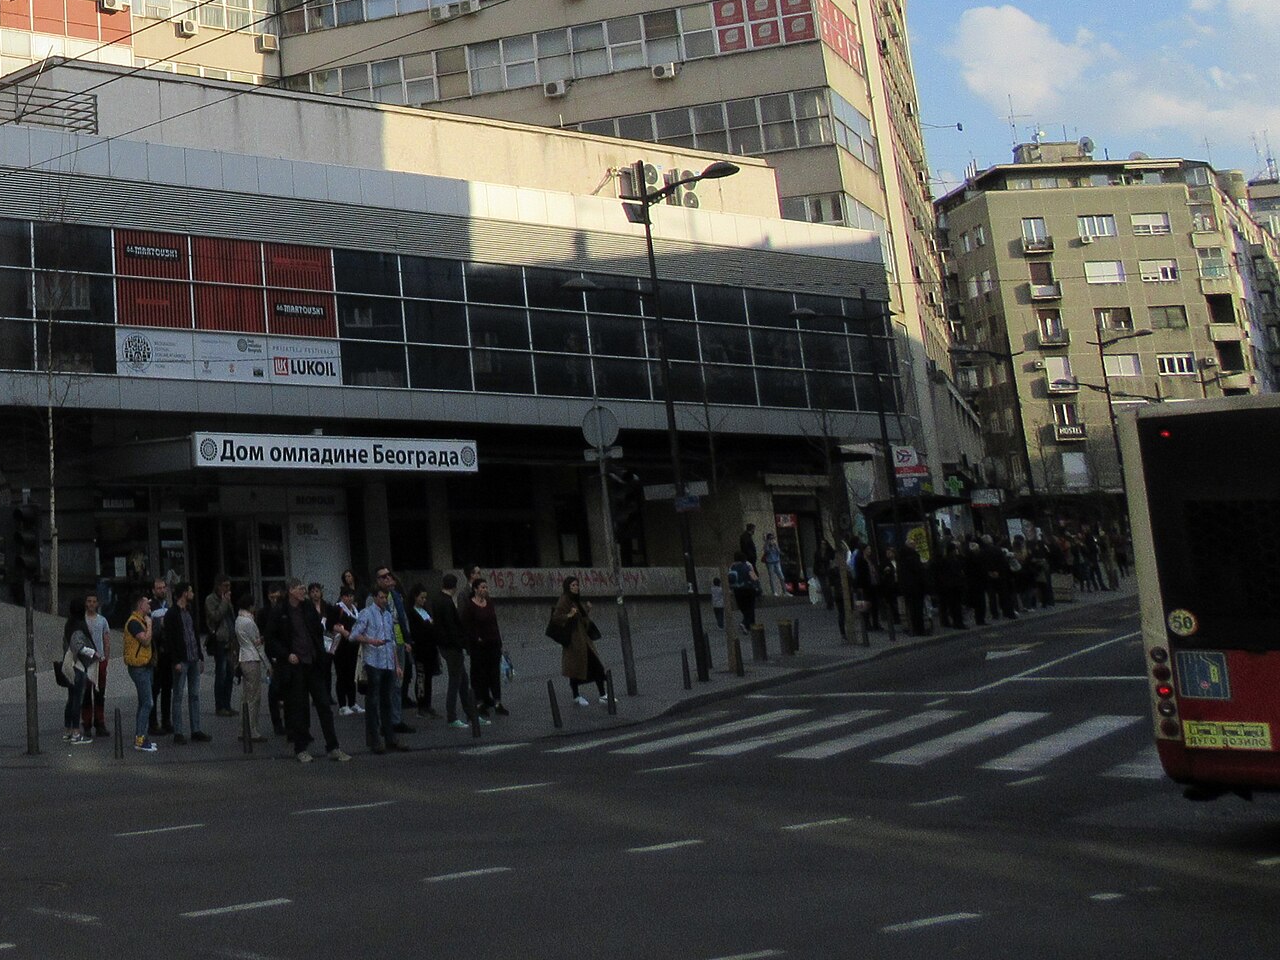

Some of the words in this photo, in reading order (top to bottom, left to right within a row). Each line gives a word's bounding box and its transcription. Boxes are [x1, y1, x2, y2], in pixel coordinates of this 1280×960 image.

[291, 359, 336, 376] LUKOIL
[220, 440, 264, 462] Дом
[270, 443, 369, 466] омладине
[373, 444, 459, 468] Београда
[1173, 615, 1193, 630] 50
[1222, 737, 1267, 747] ВОЗИЛО
